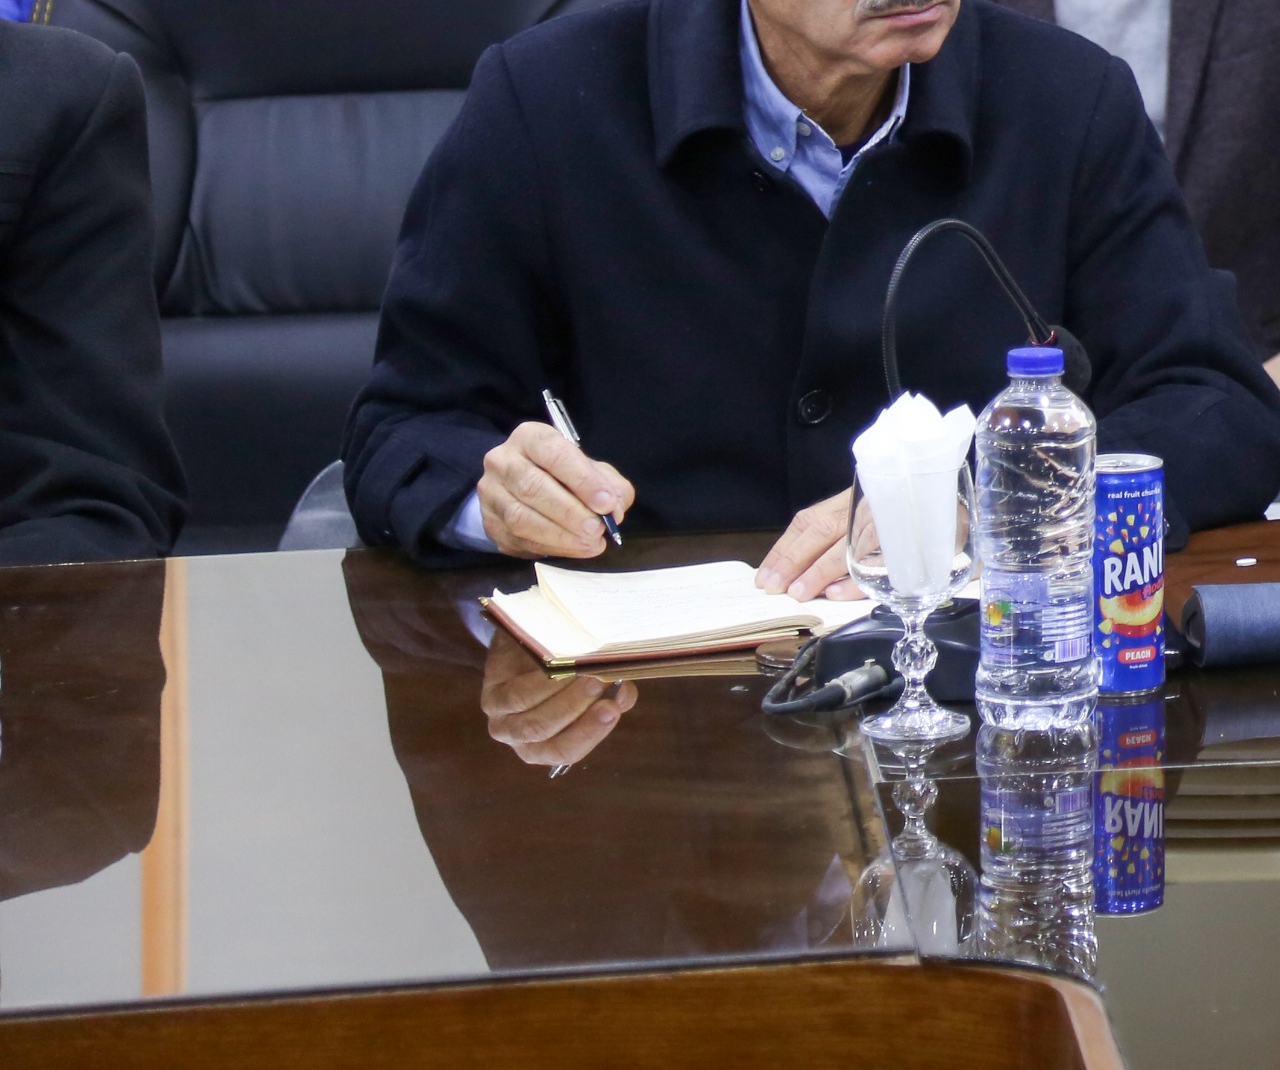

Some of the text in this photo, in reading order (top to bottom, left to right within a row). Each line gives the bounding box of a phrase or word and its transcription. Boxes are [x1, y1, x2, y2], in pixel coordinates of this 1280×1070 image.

[1108, 487, 1160, 499] real fruit chunks
[1104, 538, 1162, 595] RANI
[1126, 649, 1151, 661] PEACH
